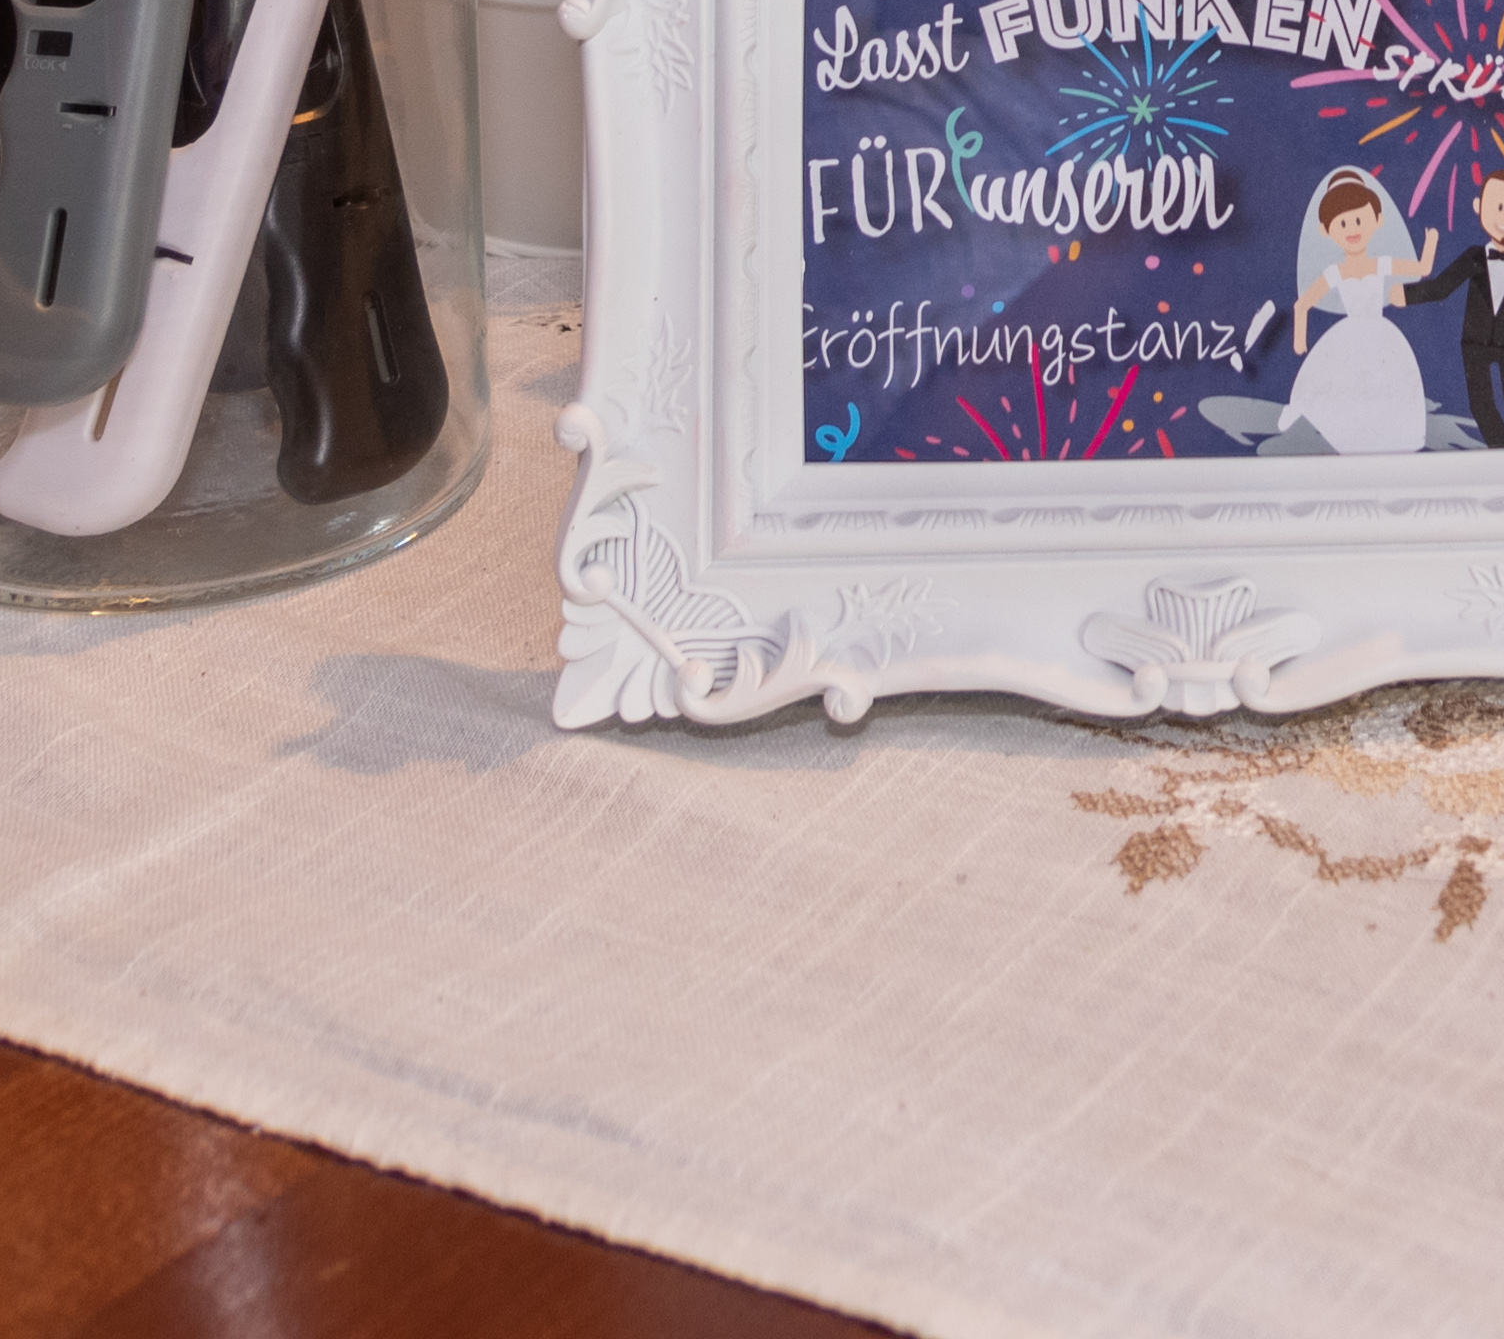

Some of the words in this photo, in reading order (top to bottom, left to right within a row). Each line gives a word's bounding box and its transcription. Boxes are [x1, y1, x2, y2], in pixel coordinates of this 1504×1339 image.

[24, 58, 55, 71] LOCK
[813, 3, 970, 92] Lasst
[808, 135, 956, 244] FÜR
[971, 152, 1234, 234] unseren
